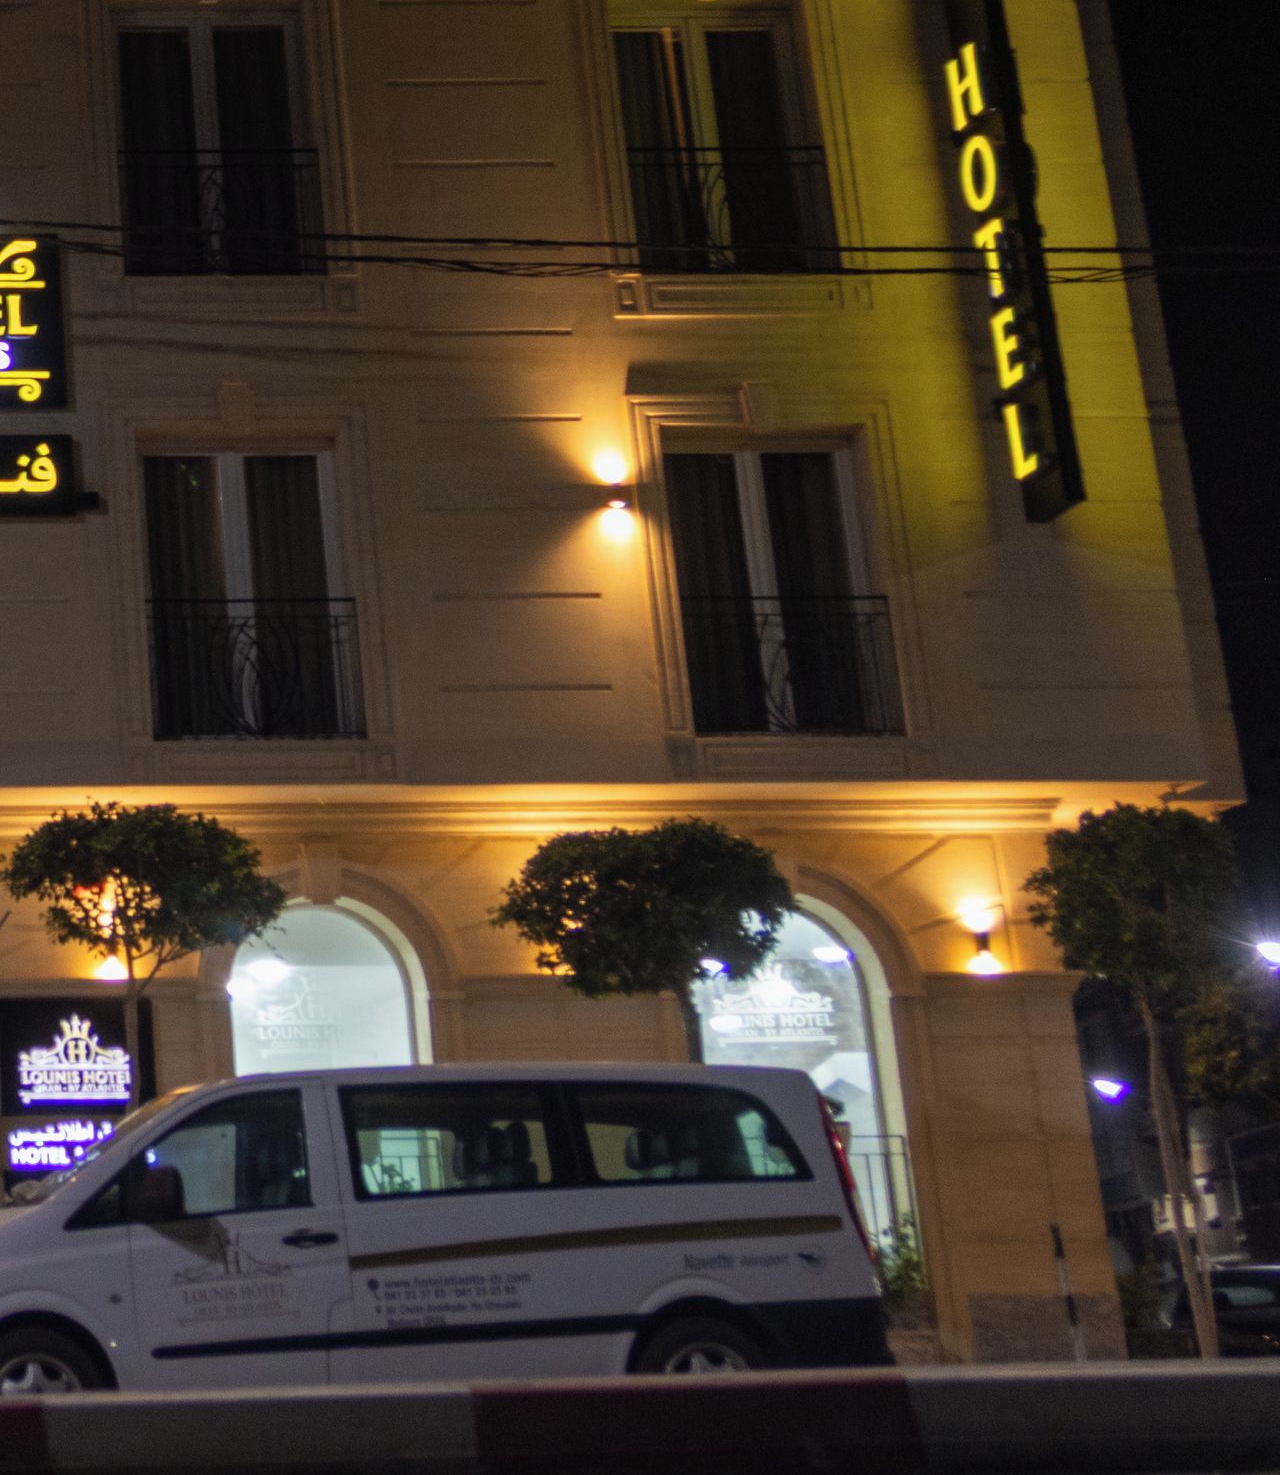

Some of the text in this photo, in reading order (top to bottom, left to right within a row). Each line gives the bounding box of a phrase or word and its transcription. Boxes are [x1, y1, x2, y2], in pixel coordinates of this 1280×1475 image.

[945, 41, 1039, 481] HOTEL
[780, 1013, 834, 1027] HOTEL
[21, 1070, 81, 1085] LOUNIS
[10, 1146, 71, 1165] HOTEL
[183, 1282, 288, 1305] LOUNIS HOTEL
